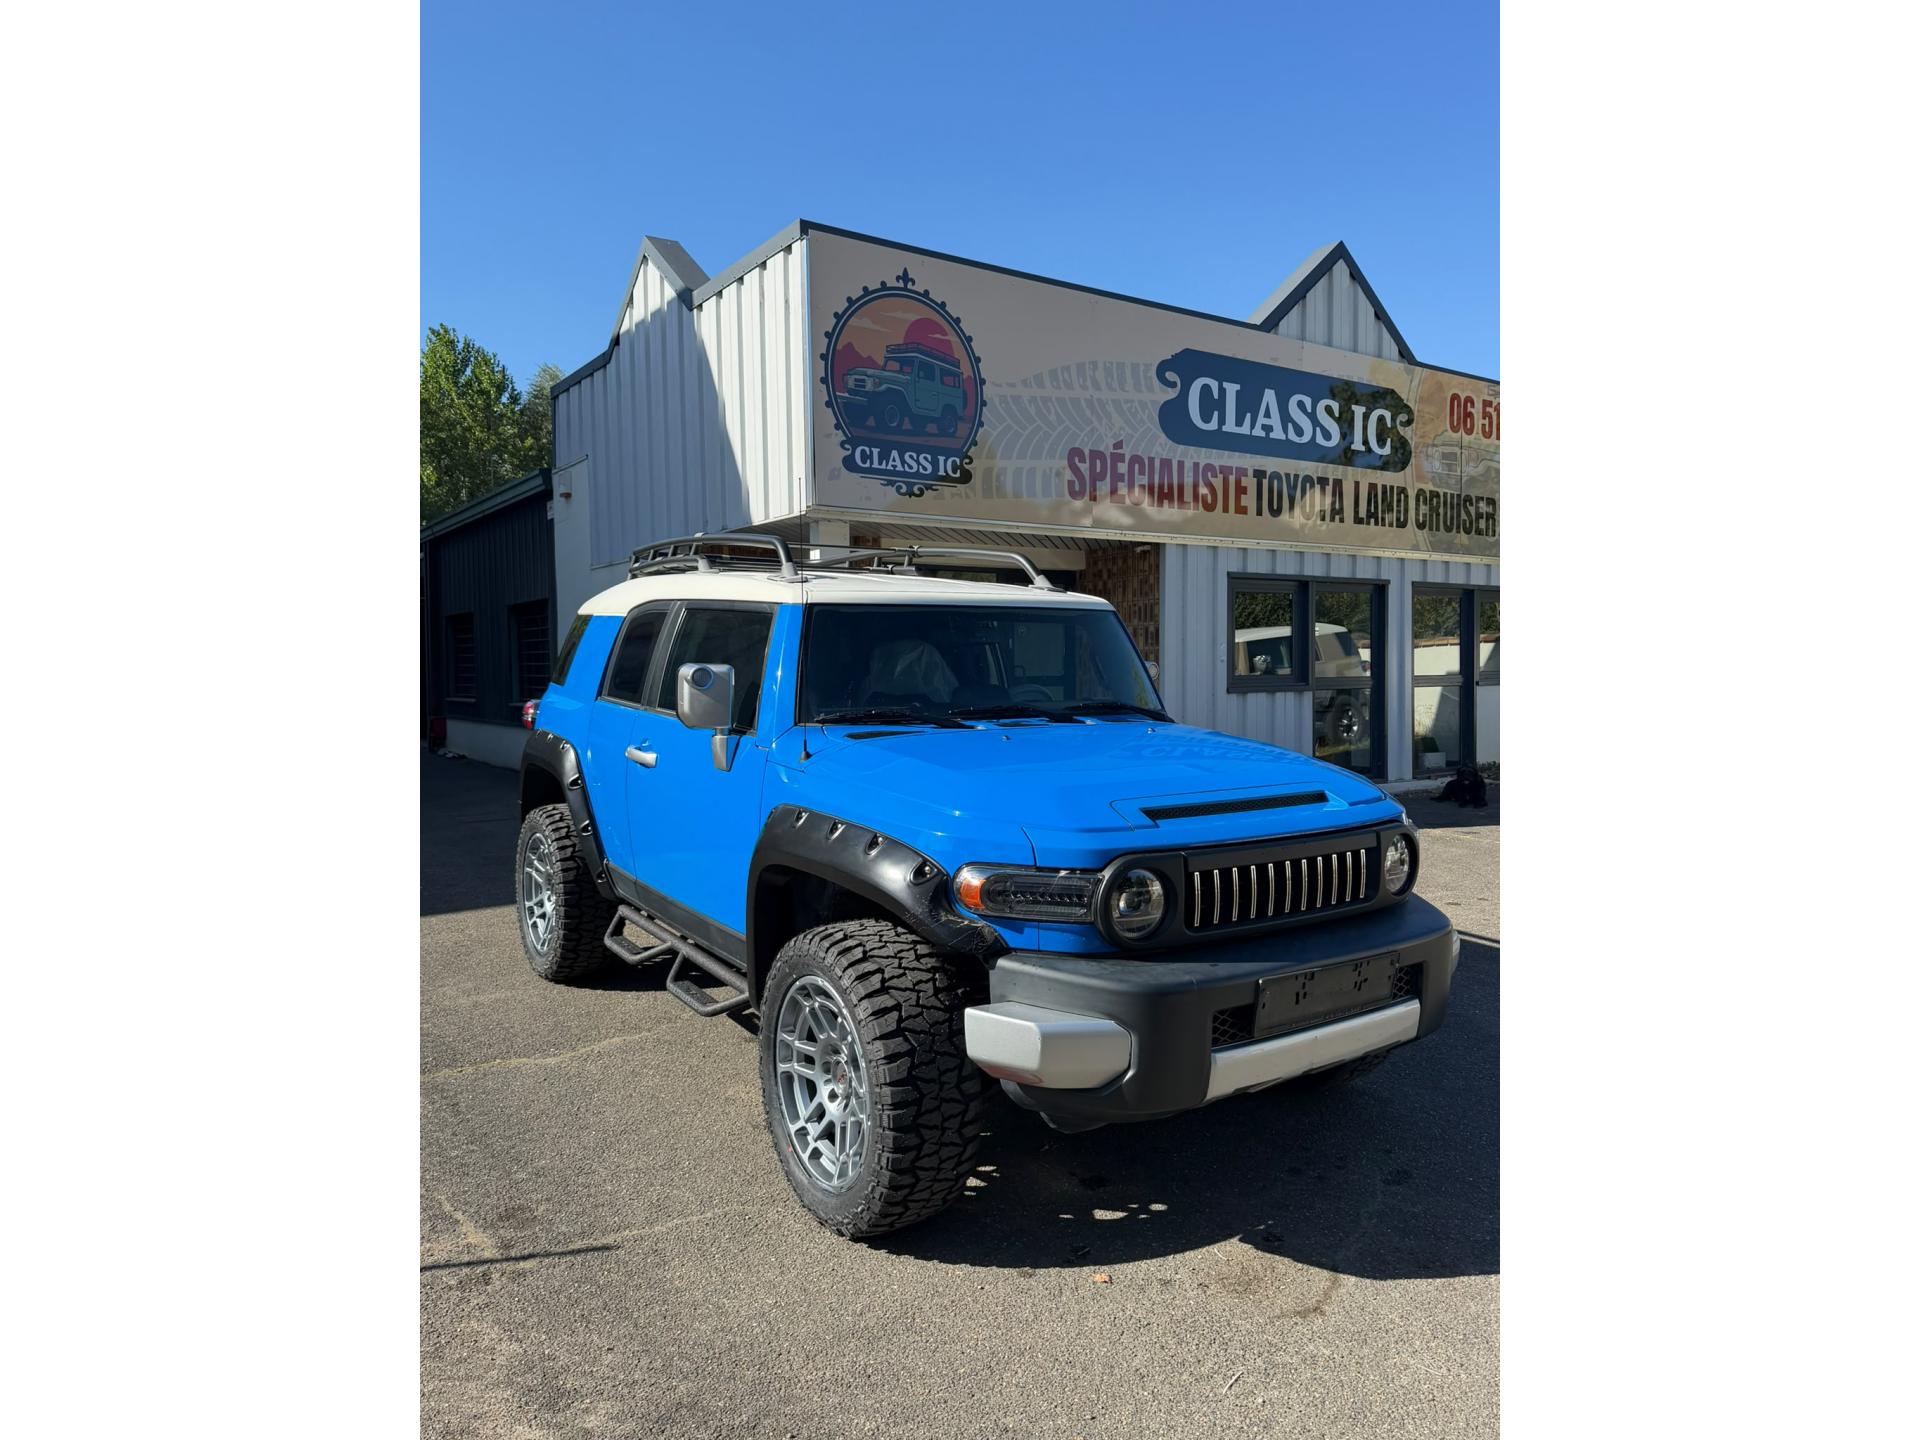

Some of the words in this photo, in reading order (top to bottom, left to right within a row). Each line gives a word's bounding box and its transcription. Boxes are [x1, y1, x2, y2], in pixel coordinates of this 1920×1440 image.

[1187, 376, 1341, 448] CLASS
[1350, 404, 1392, 455] IC
[1449, 392, 1475, 436] 06
[1481, 398, 1500, 441] 51
[854, 445, 932, 475] CLASS
[937, 456, 961, 477] IC
[1066, 439, 1249, 516] SPÉCIALISTE
[1252, 468, 1345, 523] TOYOTA
[1353, 480, 1409, 529] LAND
[1414, 488, 1496, 537] CRUISER
